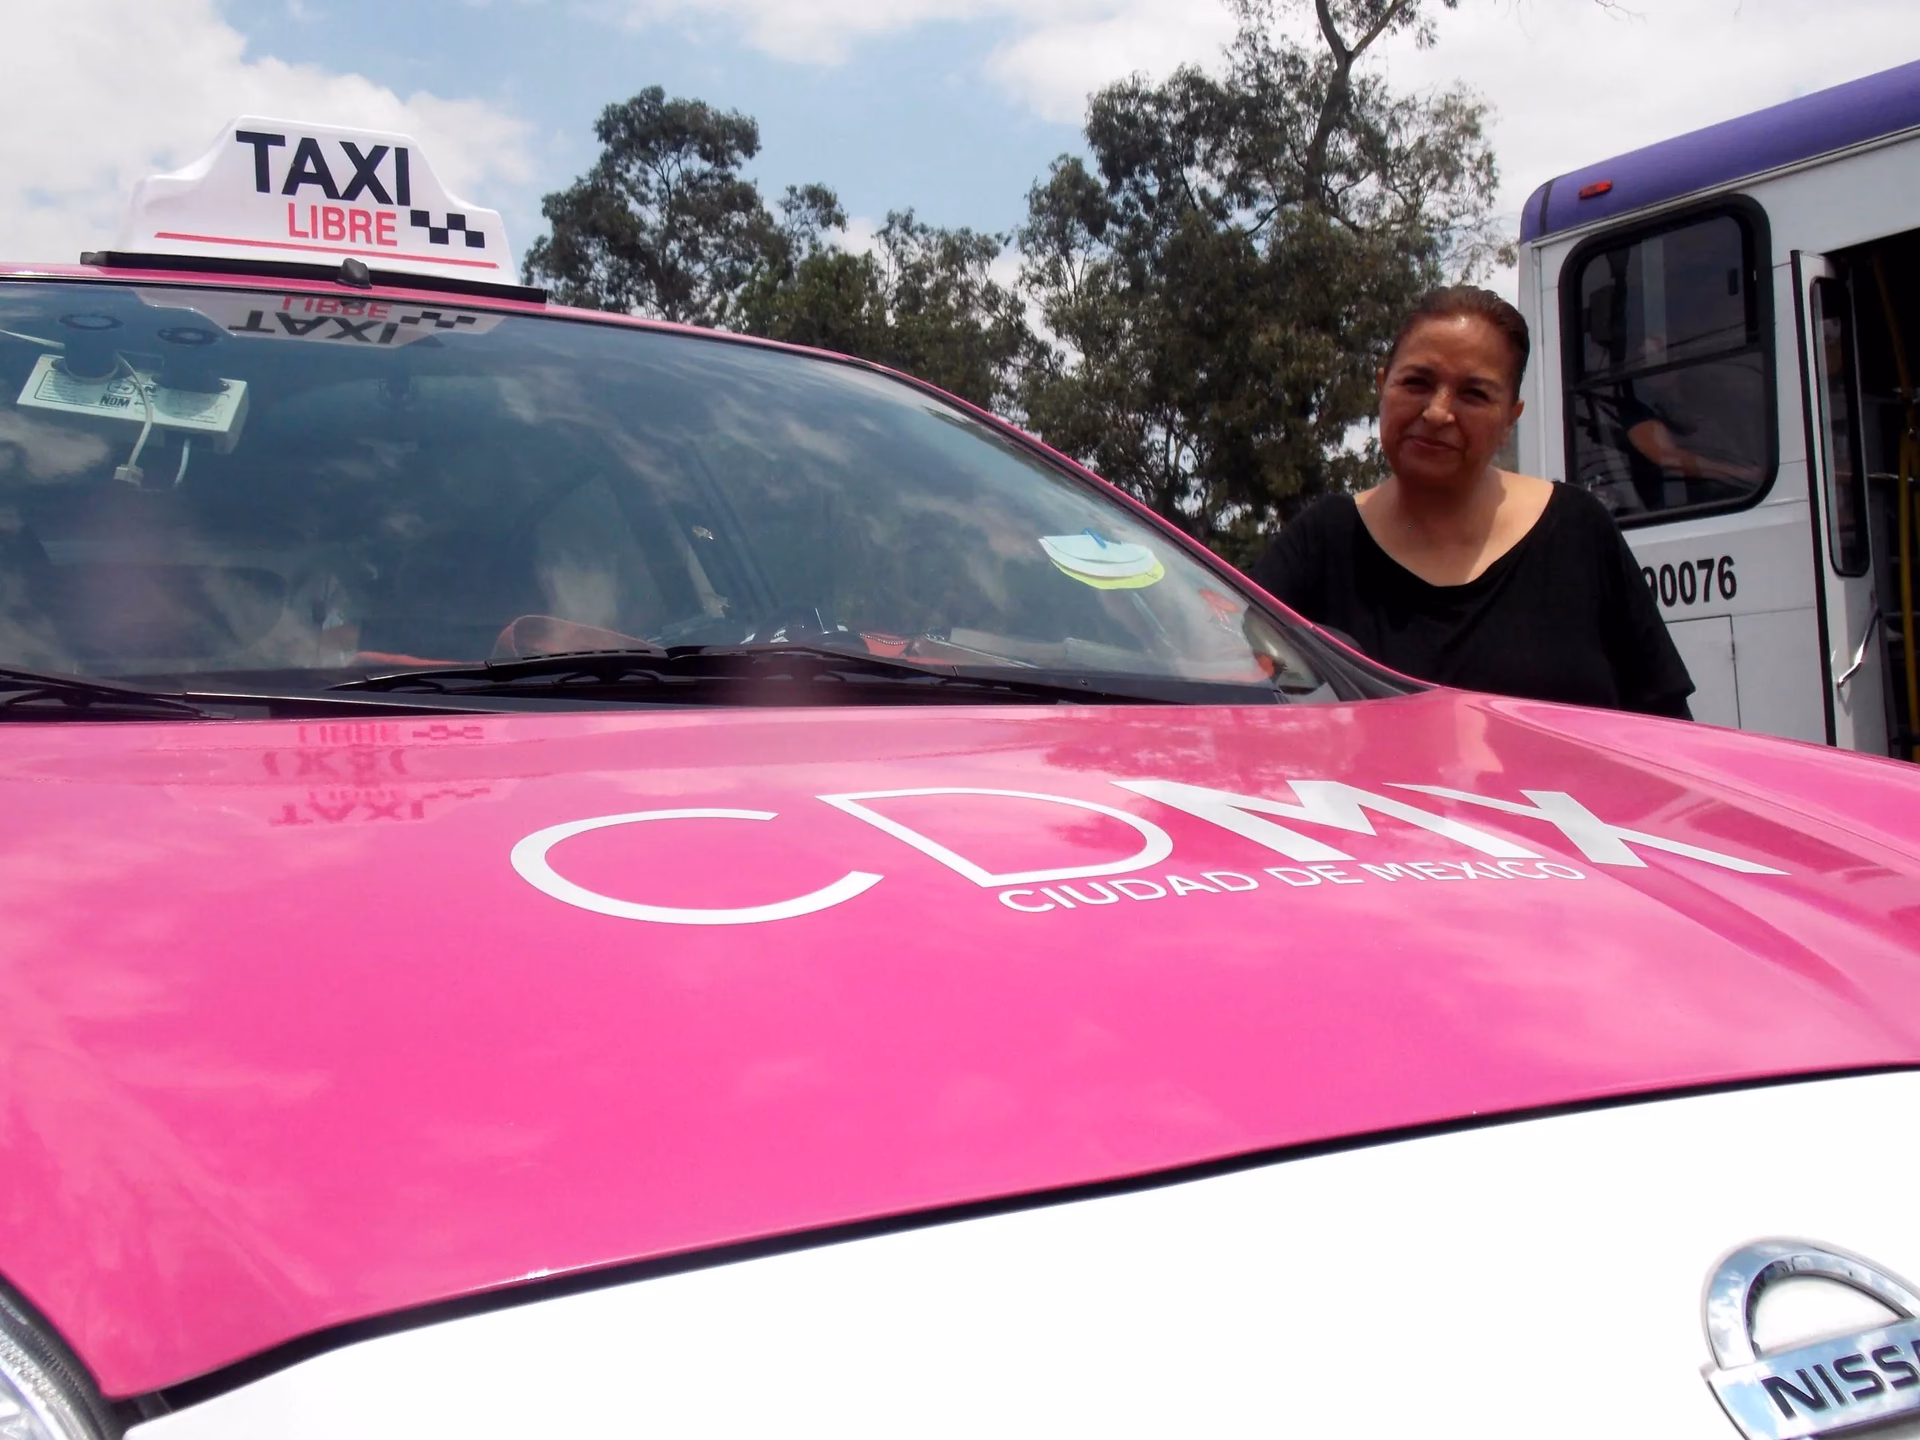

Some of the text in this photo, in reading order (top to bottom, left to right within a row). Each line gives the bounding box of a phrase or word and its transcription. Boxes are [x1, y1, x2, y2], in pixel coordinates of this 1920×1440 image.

[235, 130, 411, 207] TAXI
[287, 202, 398, 246] LIBRE
[510, 779, 1789, 925] CDMX
[998, 860, 1586, 913] CIUDAD DE MEXICO
